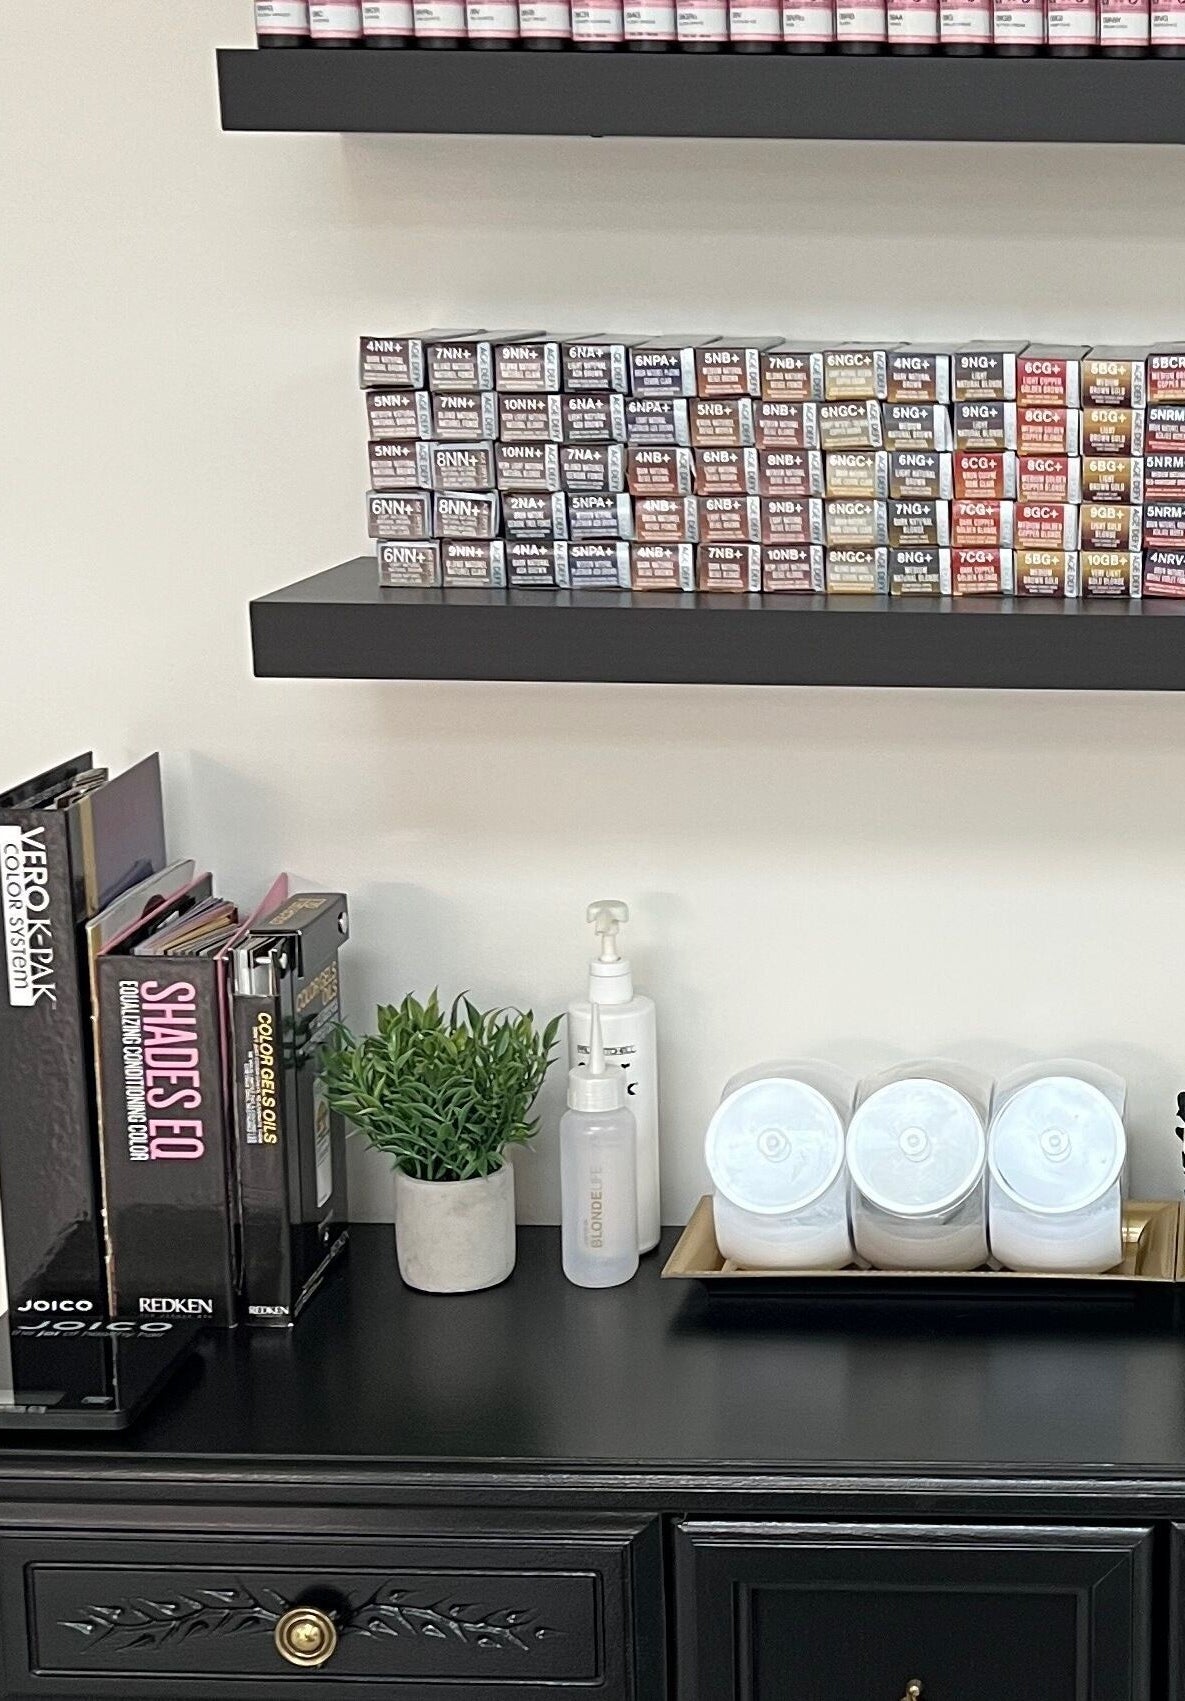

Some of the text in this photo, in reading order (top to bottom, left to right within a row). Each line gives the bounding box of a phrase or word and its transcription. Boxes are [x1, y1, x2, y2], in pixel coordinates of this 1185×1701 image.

[366, 340, 402, 352] 4NN+
[436, 348, 471, 359] 7NN+
[374, 396, 410, 407] 5NN+
[440, 399, 475, 409] 7NN+
[504, 400, 546, 410] 10NN+
[374, 446, 410, 457] 5NN+
[502, 447, 543, 458] 10NN+
[567, 449, 601, 460] 7NA+
[436, 452, 478, 467] 8NN+
[371, 501, 414, 515] 6NN+
[439, 500, 480, 516] 8NN+
[511, 498, 546, 509] 2NA+
[384, 548, 425, 563] 6NN+
[4, 843, 24, 910] COLOR
[20, 826, 57, 1001] VERO K-PAK
[119, 980, 149, 1161] EQUALIZING CONDITIONING COLOR
[140, 981, 205, 1160] SHADES EQ
[258, 1012, 277, 1144] COLOR GELS OILS
[17, 1300, 93, 1312] JOICO
[139, 1298, 213, 1313] REDKEN
[248, 1305, 289, 1315] REDKEN
[17, 1320, 173, 1331] JOICO
